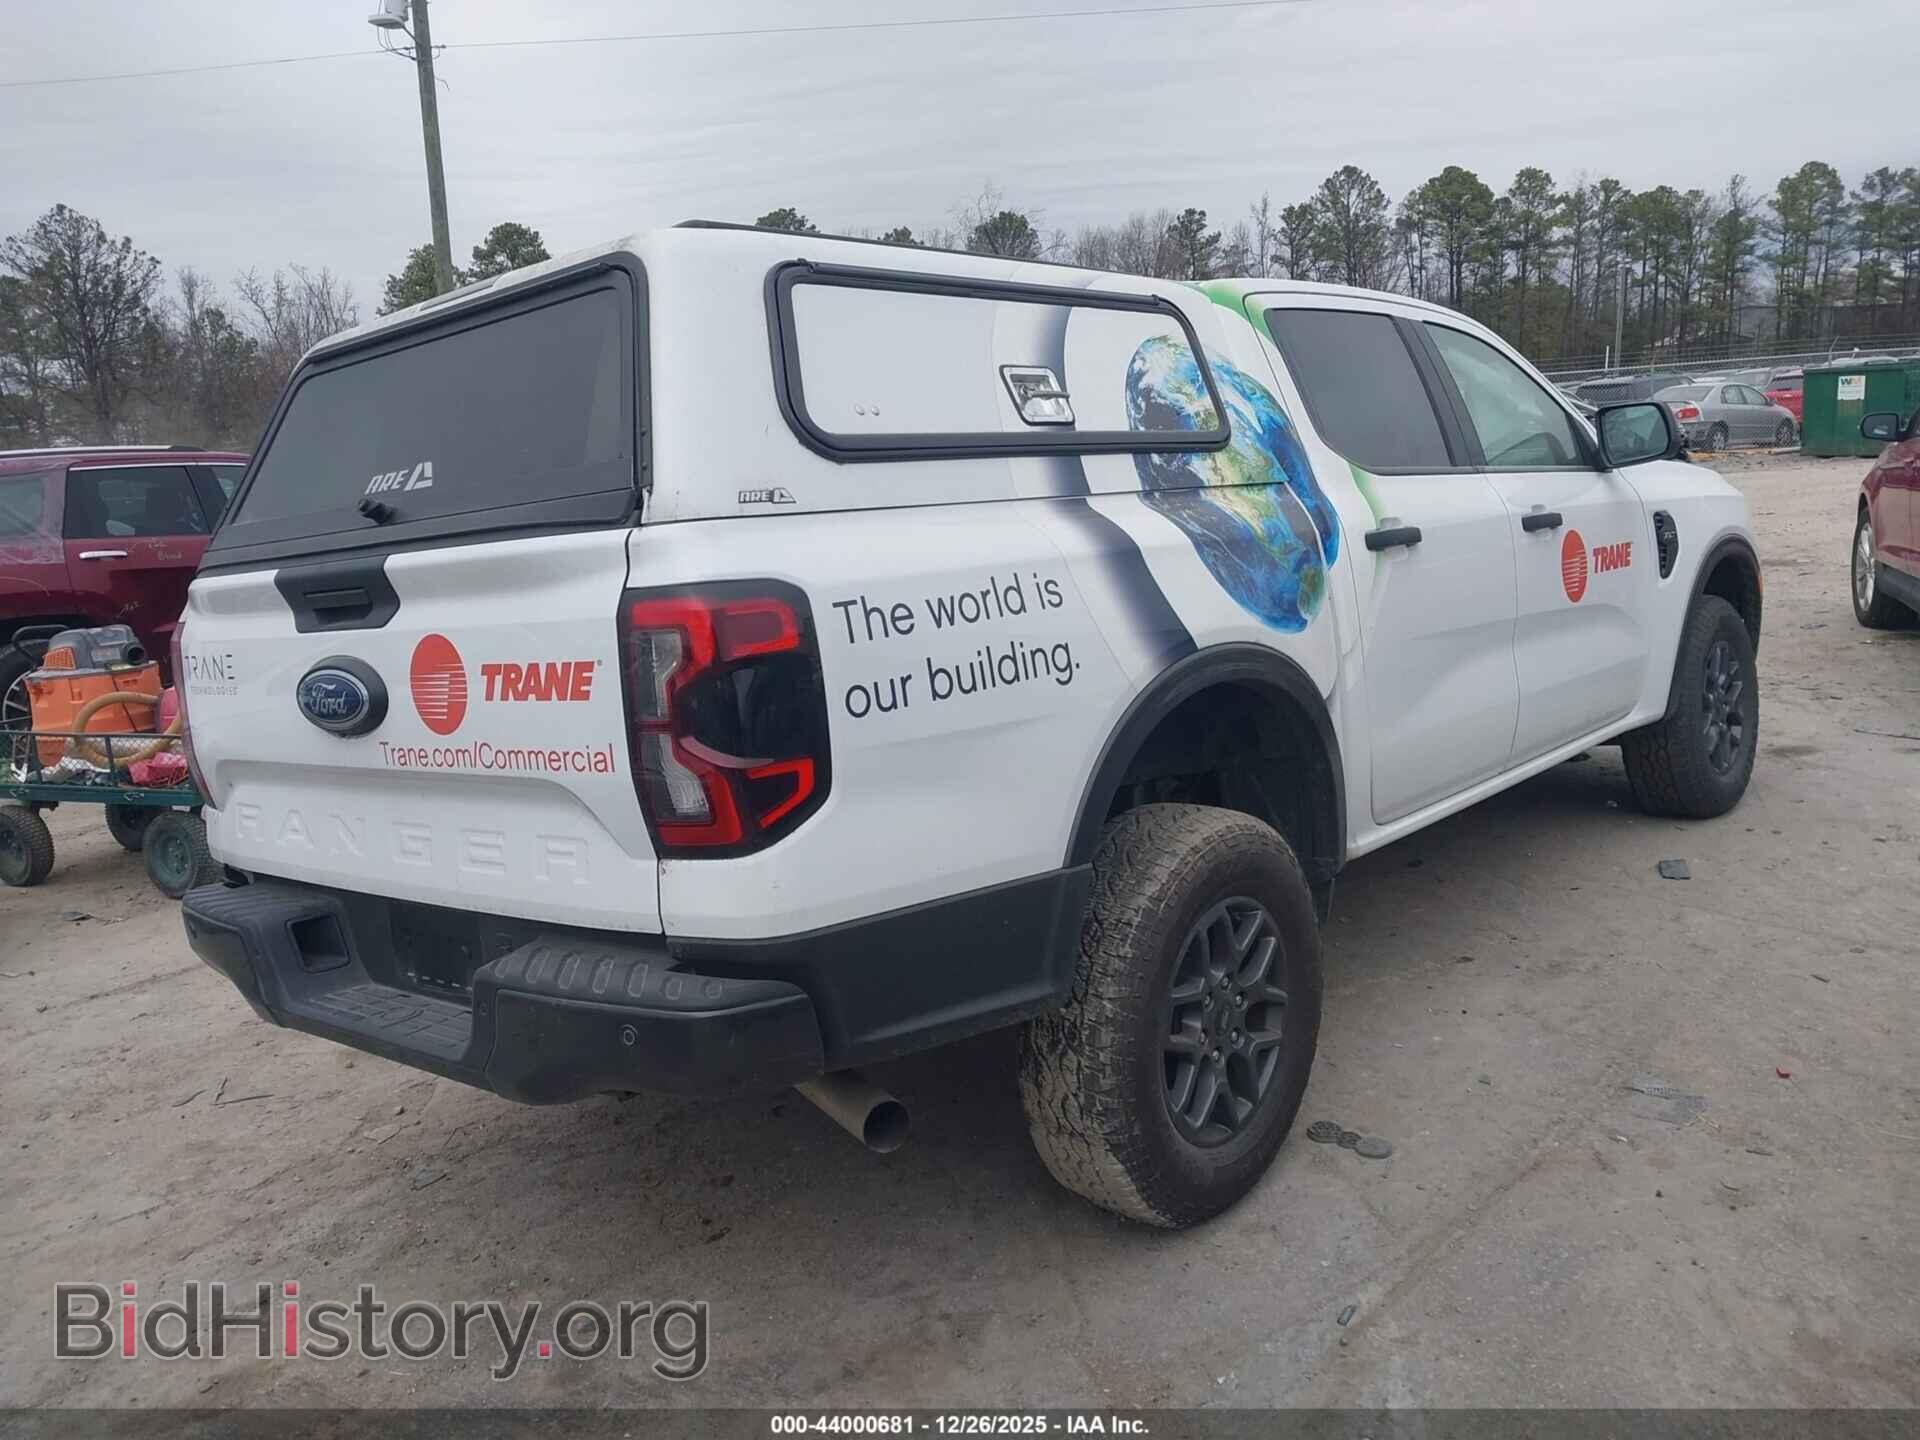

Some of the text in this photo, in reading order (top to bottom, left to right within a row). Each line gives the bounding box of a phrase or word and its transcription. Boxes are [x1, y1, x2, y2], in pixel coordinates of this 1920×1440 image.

[1592, 541, 1632, 574] TRANE
[832, 572, 1063, 644] The world is
[310, 682, 348, 714] Ford
[845, 640, 1080, 718] our building.
[379, 740, 616, 773] Trane.com/Commercial
[234, 801, 592, 886] RANGER
